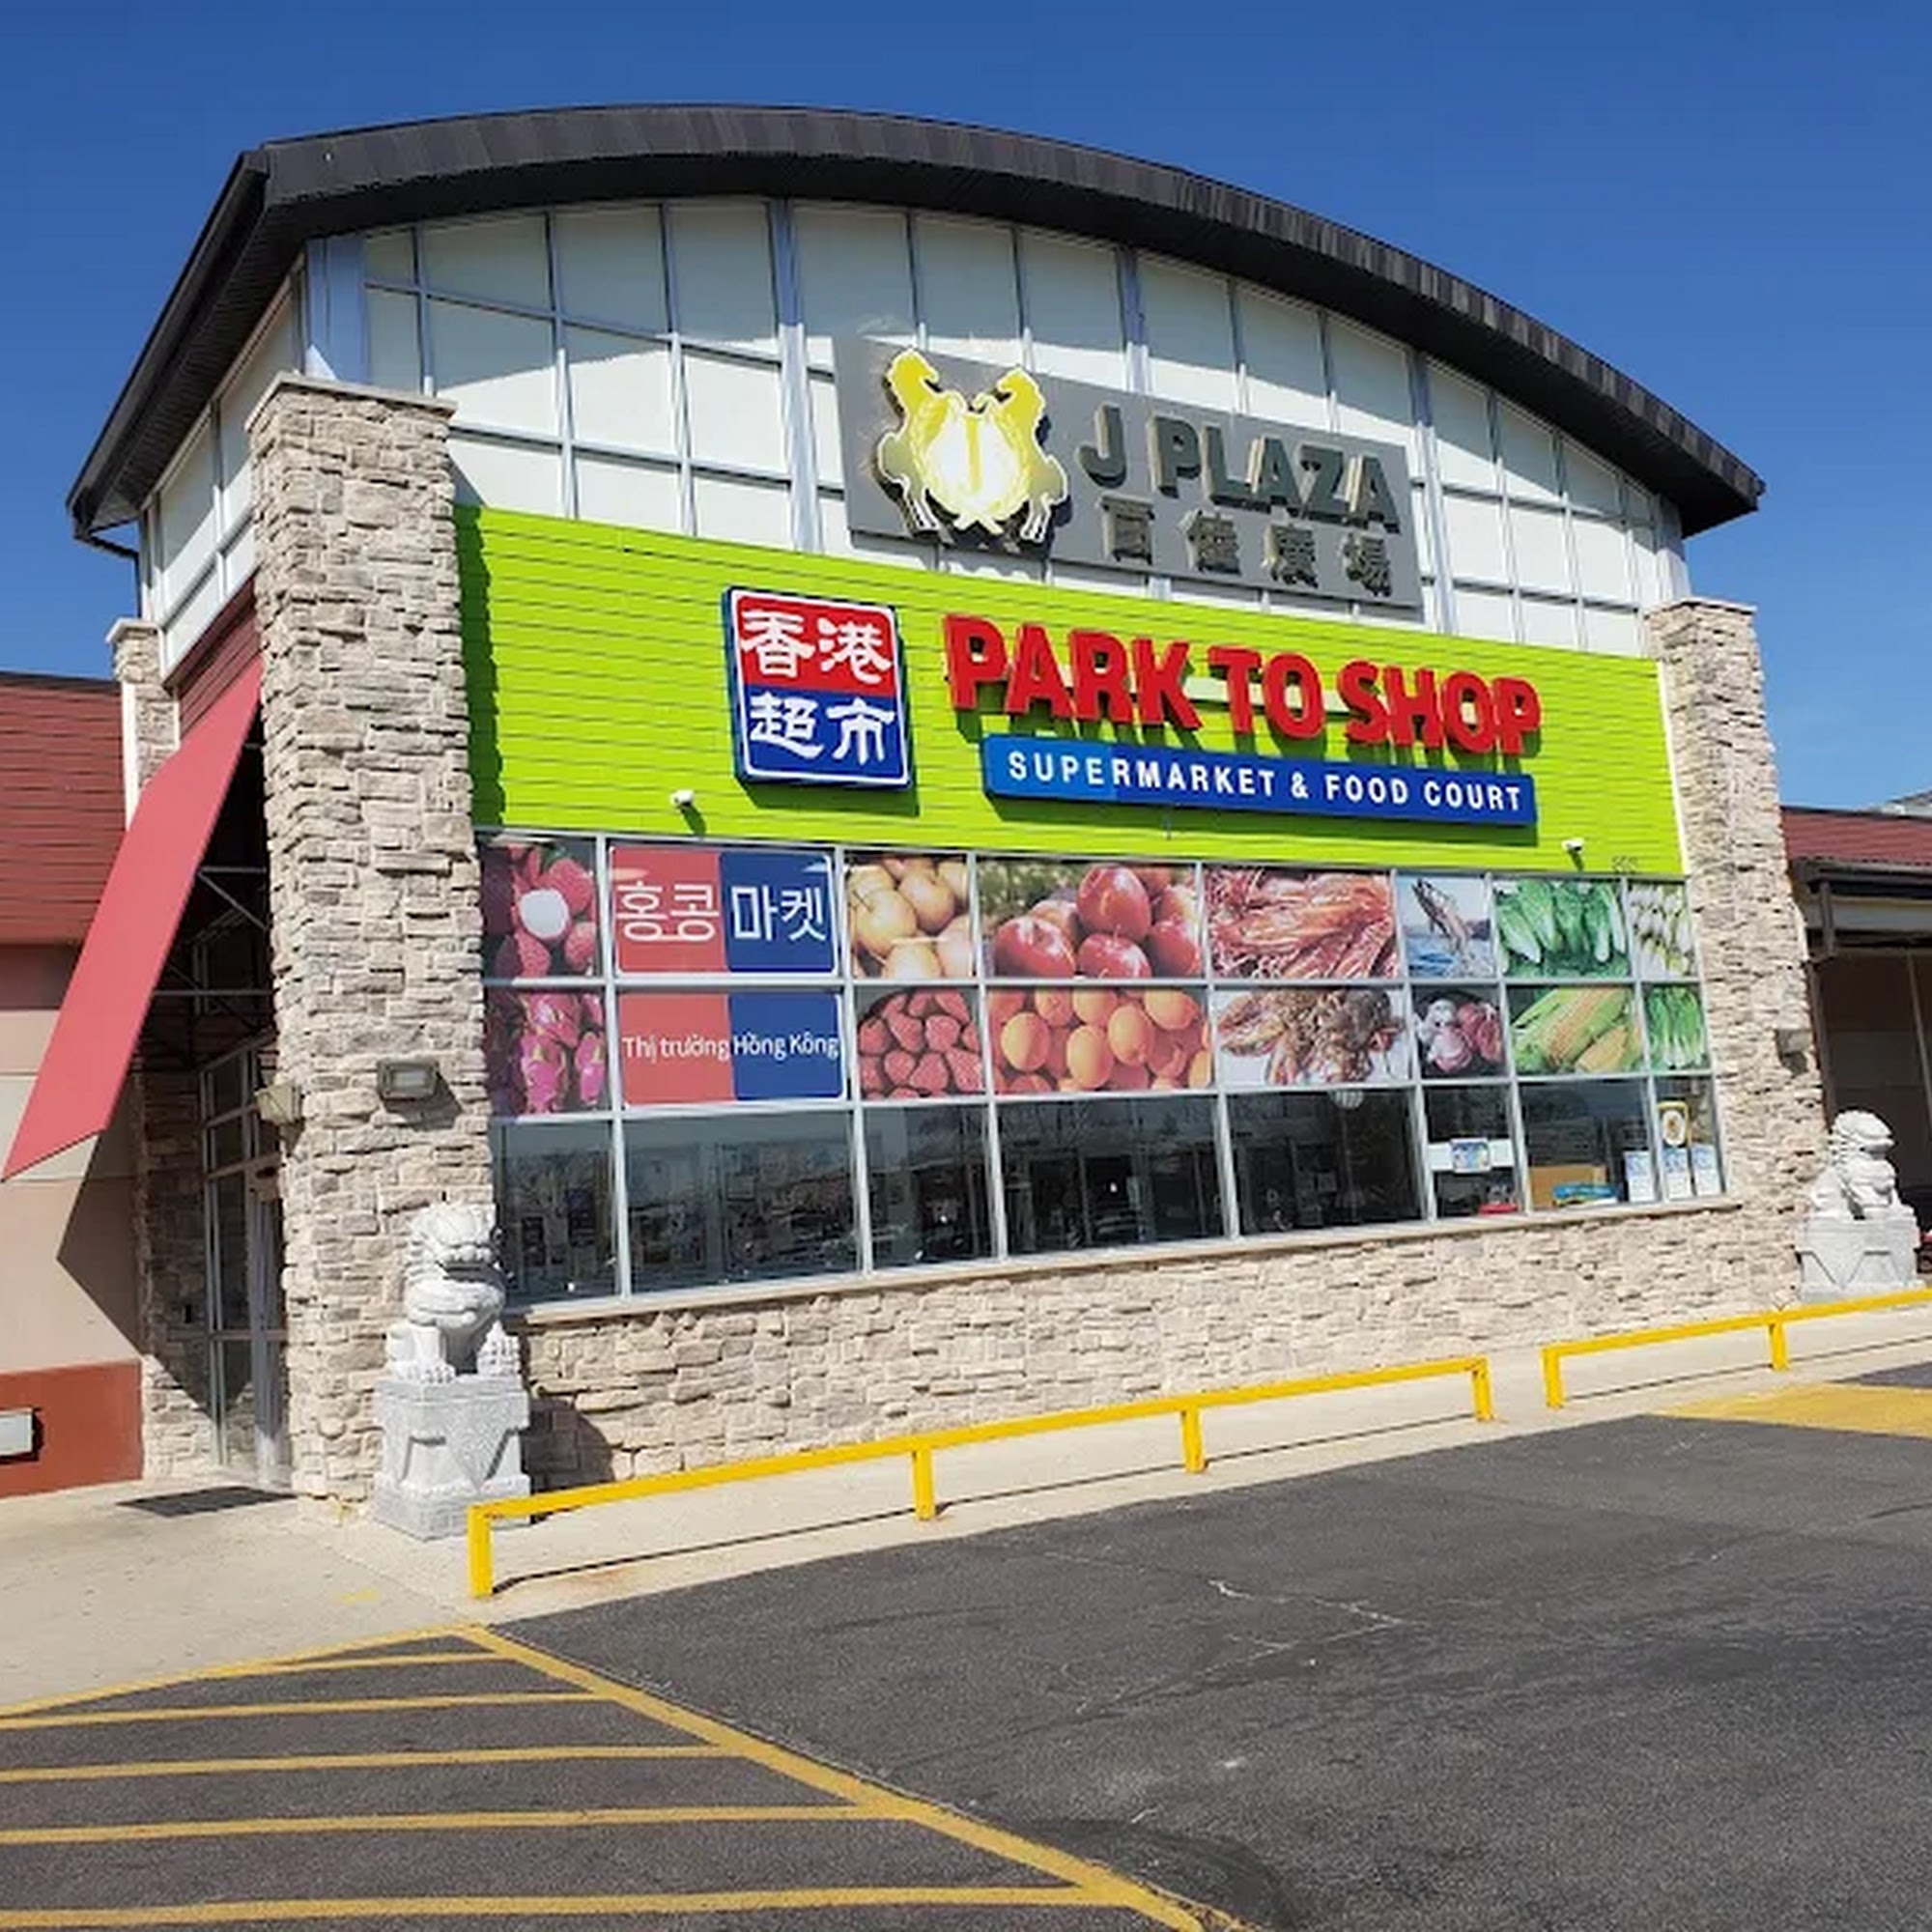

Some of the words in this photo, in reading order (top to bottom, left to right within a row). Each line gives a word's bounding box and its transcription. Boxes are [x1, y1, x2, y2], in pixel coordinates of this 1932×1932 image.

[1077, 404, 1126, 488] J
[1149, 415, 1401, 533] PLAZA
[740, 609, 894, 684] 香港
[943, 612, 1204, 730] PARK
[1208, 645, 1327, 742] TO
[1335, 658, 1543, 755] SHOP
[749, 690, 896, 766] 超市
[1008, 750, 1275, 798] SUPERMARKET
[1290, 771, 1310, 800] &
[1324, 774, 1409, 805] FOOD
[1423, 780, 1521, 811] COURT
[615, 880, 721, 943] 홍콩
[730, 884, 827, 942] 마켓
